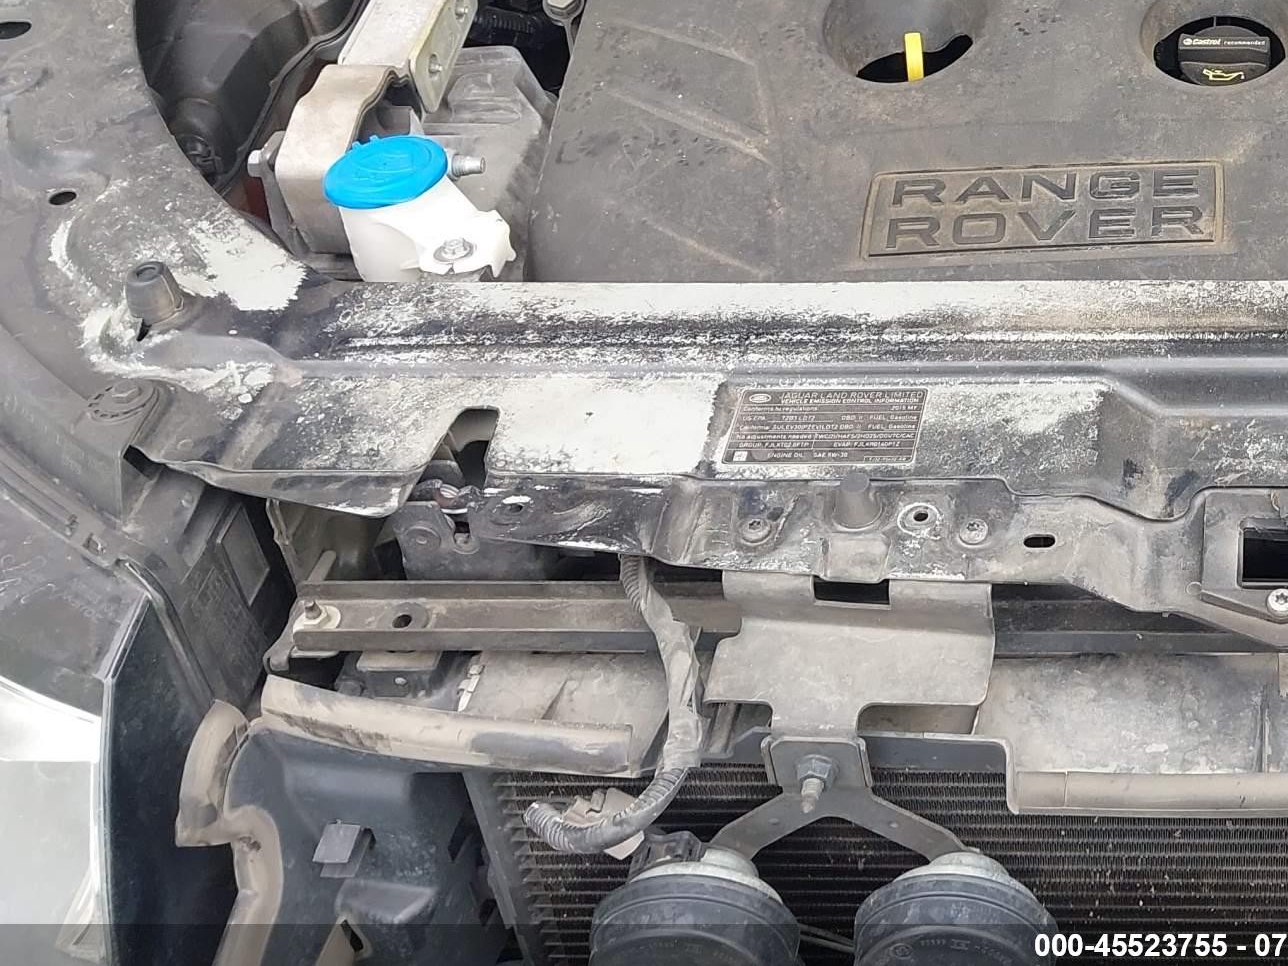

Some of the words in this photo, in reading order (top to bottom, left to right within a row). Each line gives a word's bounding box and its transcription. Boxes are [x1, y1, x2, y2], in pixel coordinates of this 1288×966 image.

[1192, 38, 1221, 46] Castrol
[1223, 39, 1266, 47] recommended
[891, 169, 1200, 207] RANGE
[886, 206, 1204, 249] ROVER
[820, 391, 848, 399] LAND
[849, 391, 882, 399] ROVER
[884, 391, 923, 399] LIMITED
